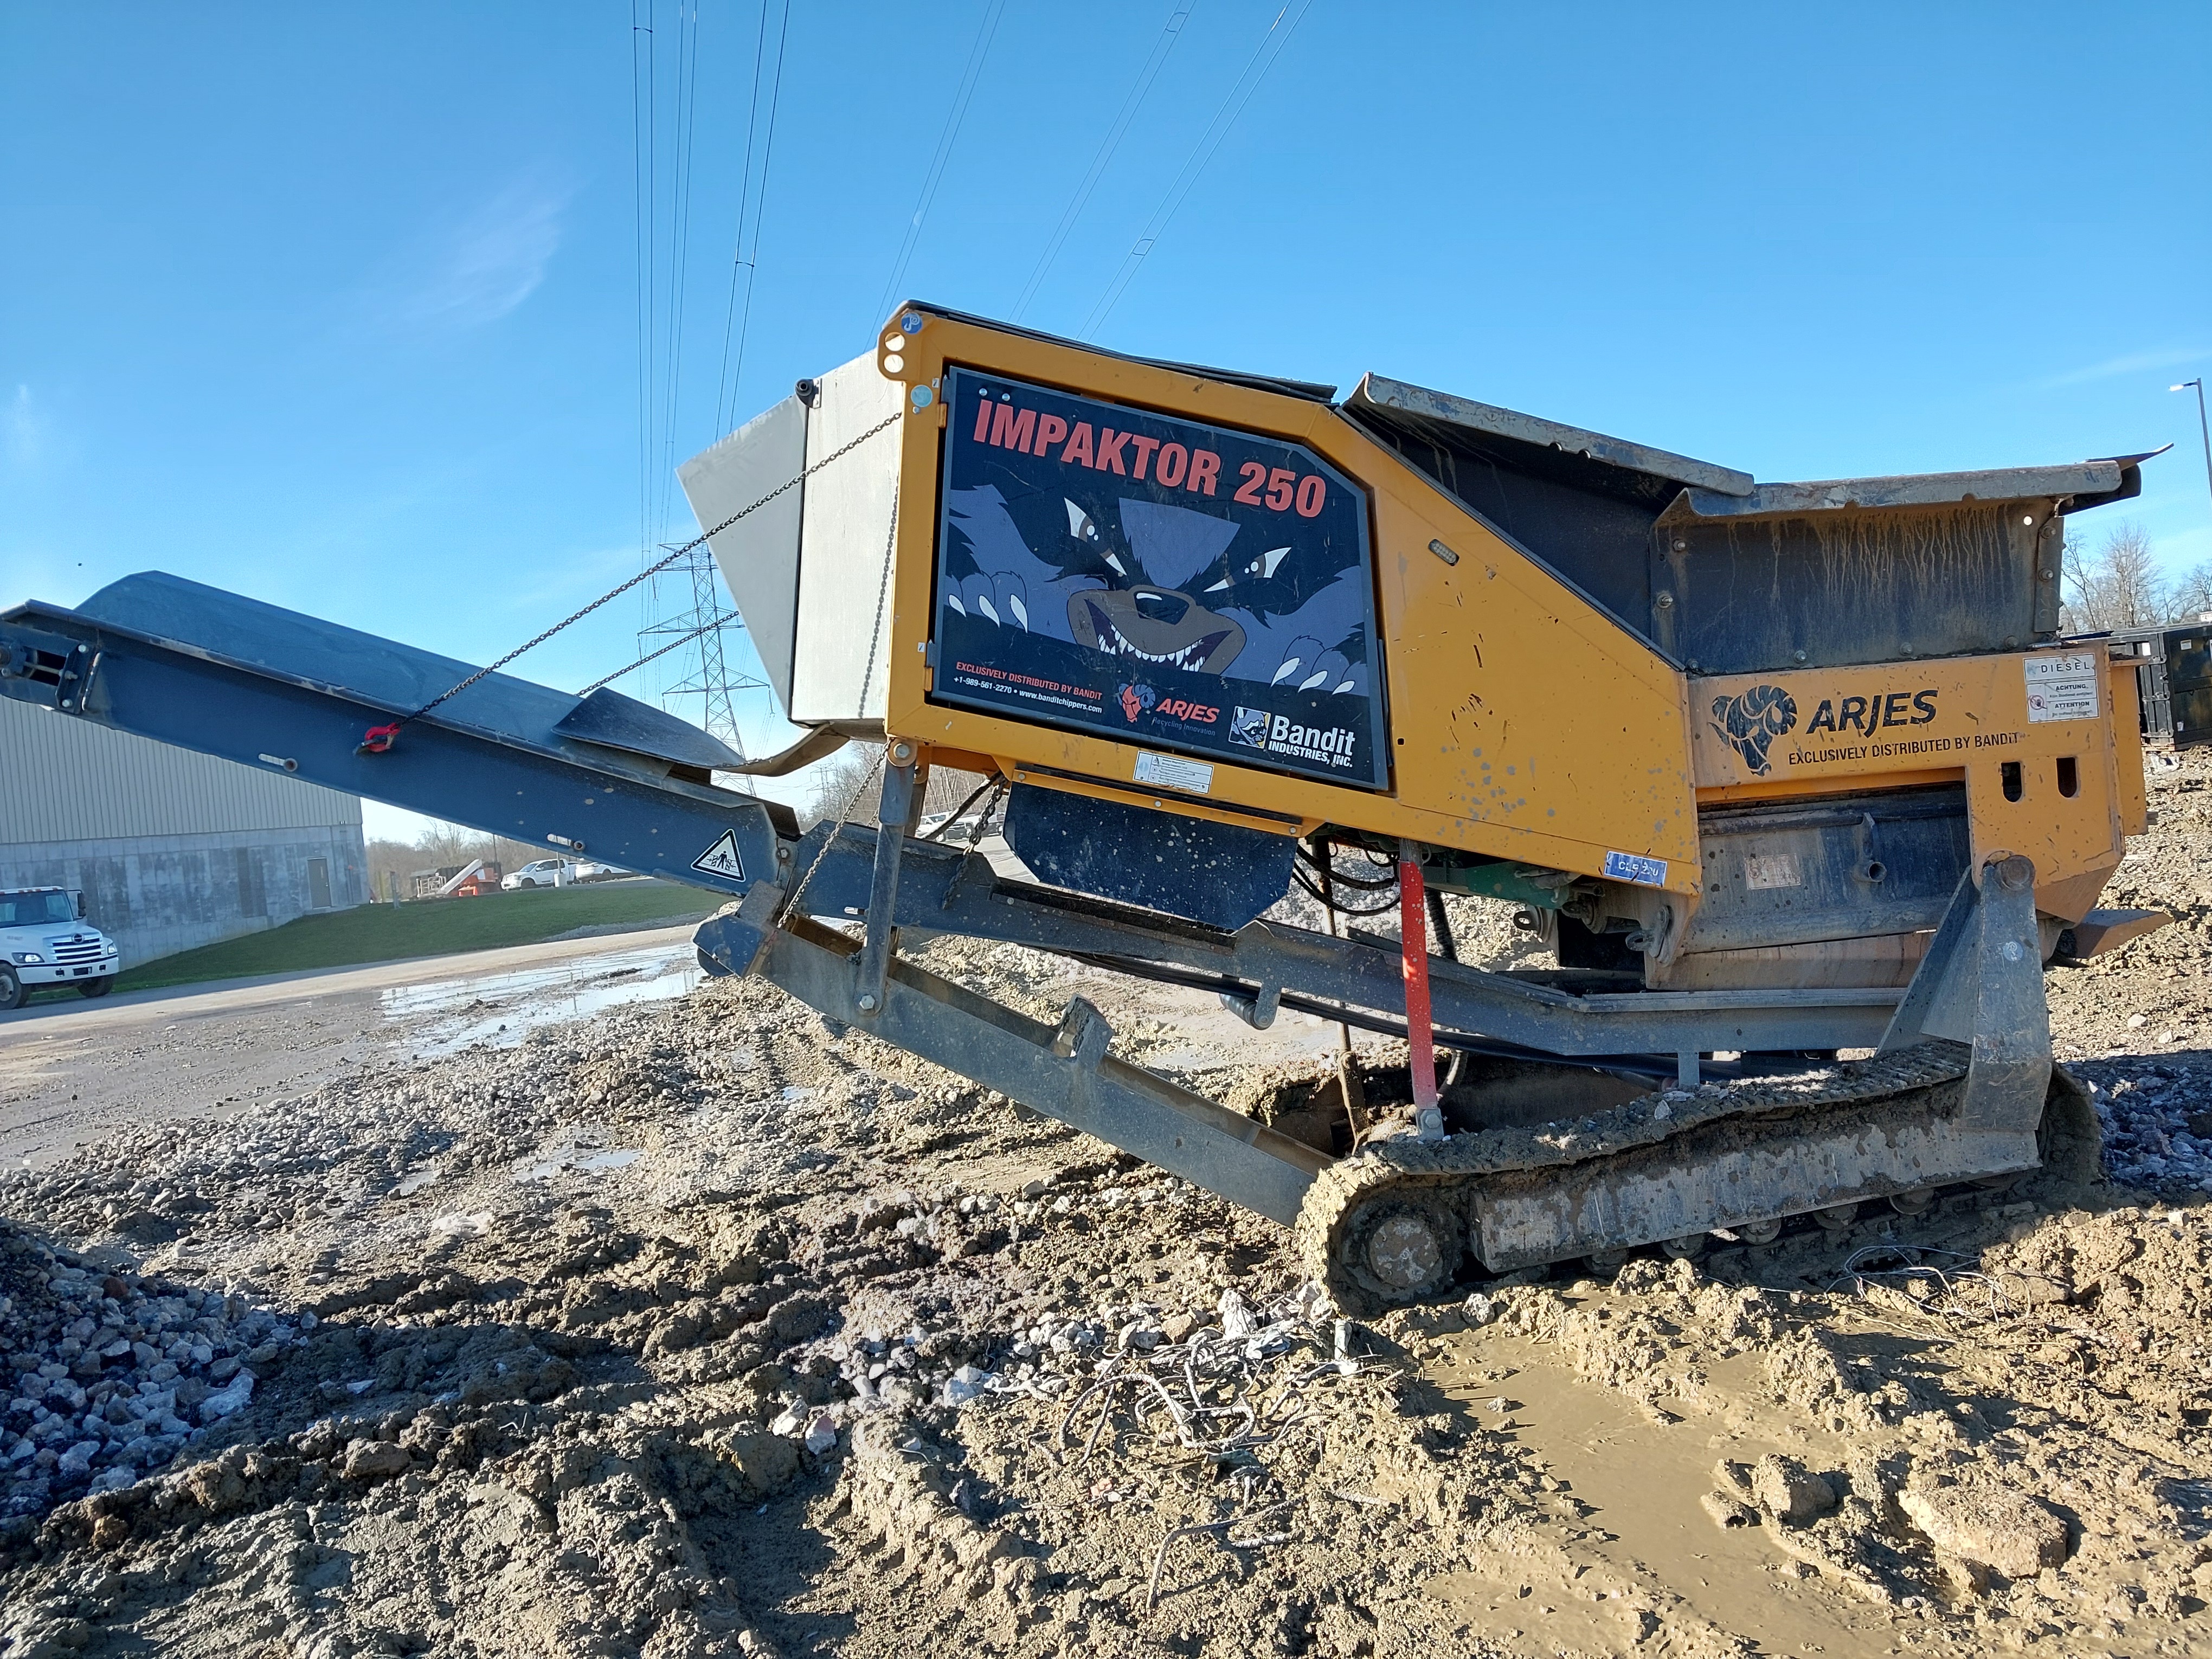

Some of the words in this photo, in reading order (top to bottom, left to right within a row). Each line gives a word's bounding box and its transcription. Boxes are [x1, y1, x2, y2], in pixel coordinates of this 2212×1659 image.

[973, 399, 1221, 496] IMPAKTOR
[1233, 462, 1327, 518] 250
[955, 661, 1007, 680] EXCLUSIVELY
[1009, 673, 1059, 691] DISTRIBUTED
[1061, 684, 1072, 693] BY
[1073, 688, 1102, 700] BANDIT
[2041, 661, 2090, 673] DIESEL
[954, 676, 1012, 694] +1-989-561-2270
[1019, 690, 1102, 713] www.banditchippers.com
[1155, 698, 1220, 723] ARJES
[1153, 717, 1182, 730] Recycling
[1184, 723, 1216, 736] Innovation
[1805, 690, 1939, 738] ARJES
[1271, 715, 1355, 756] Bandit
[1789, 746, 1867, 765] EXCLUSIVELY
[1872, 738, 1951, 758] DISTRIBUTED
[1955, 736, 1971, 749] BY
[1975, 732, 2019, 748] BANDIT
[1268, 741, 1330, 765] INDUSTRIES,
[1332, 754, 1353, 768] INC.
